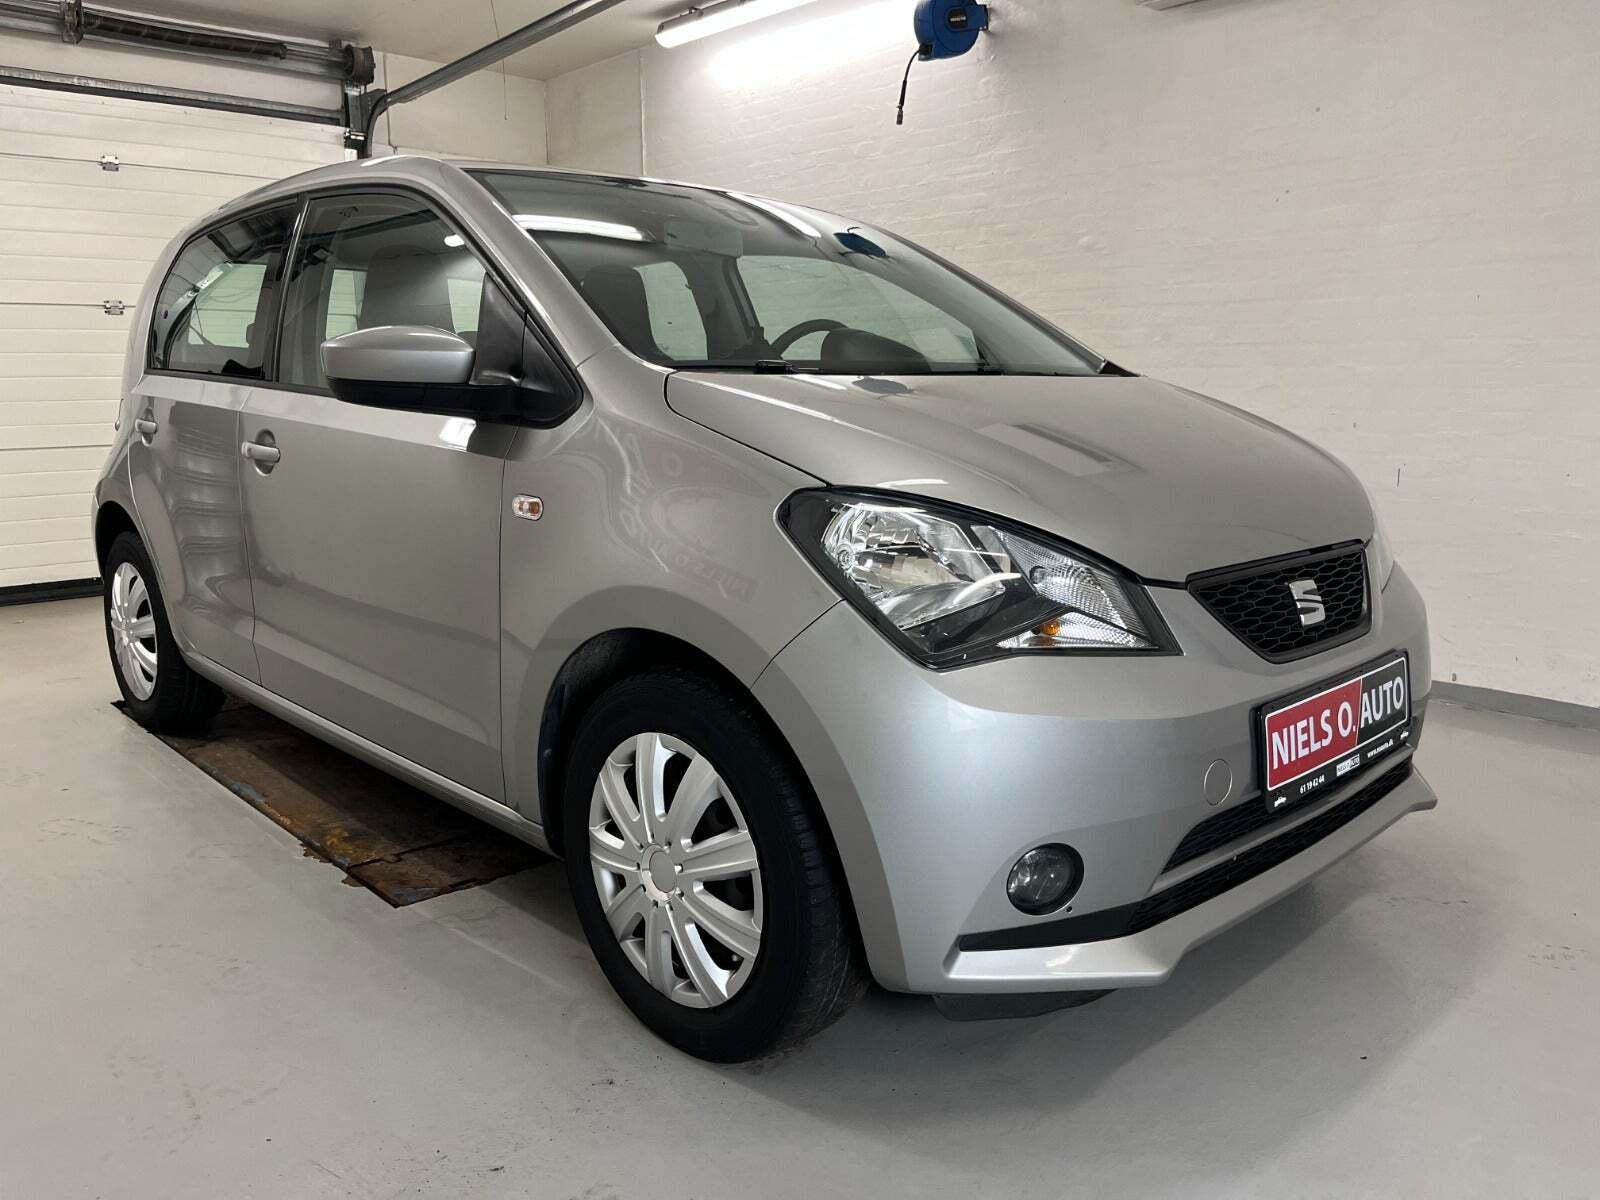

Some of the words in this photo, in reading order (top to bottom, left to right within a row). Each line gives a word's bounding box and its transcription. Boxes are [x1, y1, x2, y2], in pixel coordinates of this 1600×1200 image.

[1272, 709, 1333, 769] NIELS
[1337, 701, 1356, 737] O.
[1361, 676, 1404, 729] AUTO
